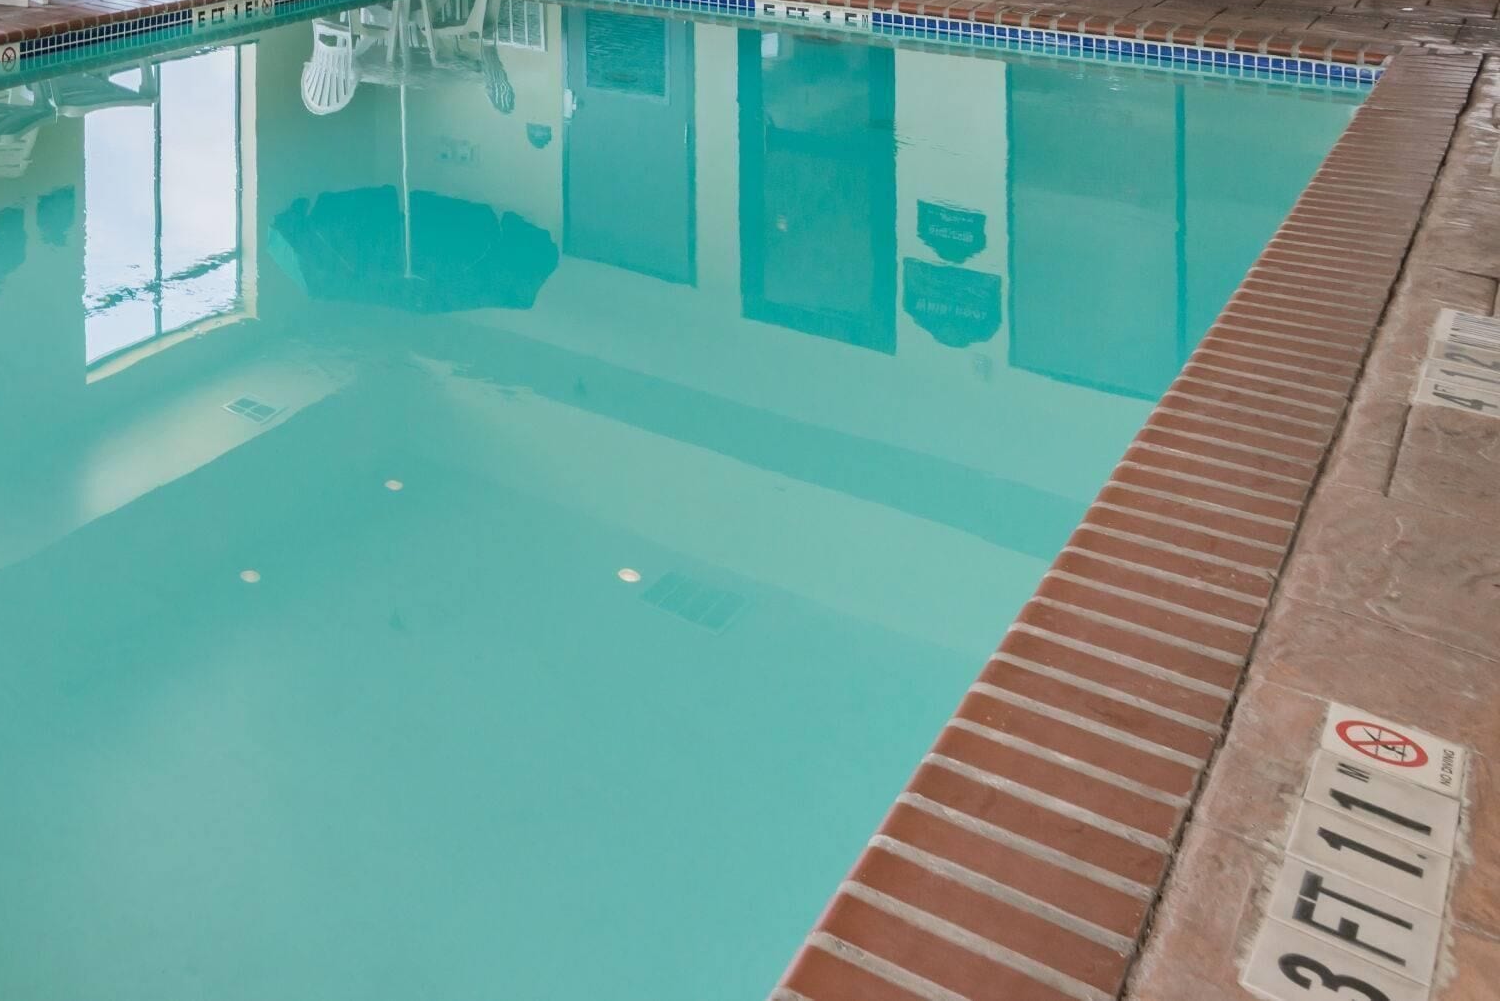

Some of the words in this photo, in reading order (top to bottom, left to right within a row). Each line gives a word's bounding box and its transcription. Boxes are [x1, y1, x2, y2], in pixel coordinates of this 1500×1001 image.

[1441, 749, 1455, 772] DIVING
[1336, 761, 1371, 784] M
[1440, 770, 1453, 786] NO
[1292, 870, 1414, 968] FT
[1277, 952, 1391, 1001] 3
